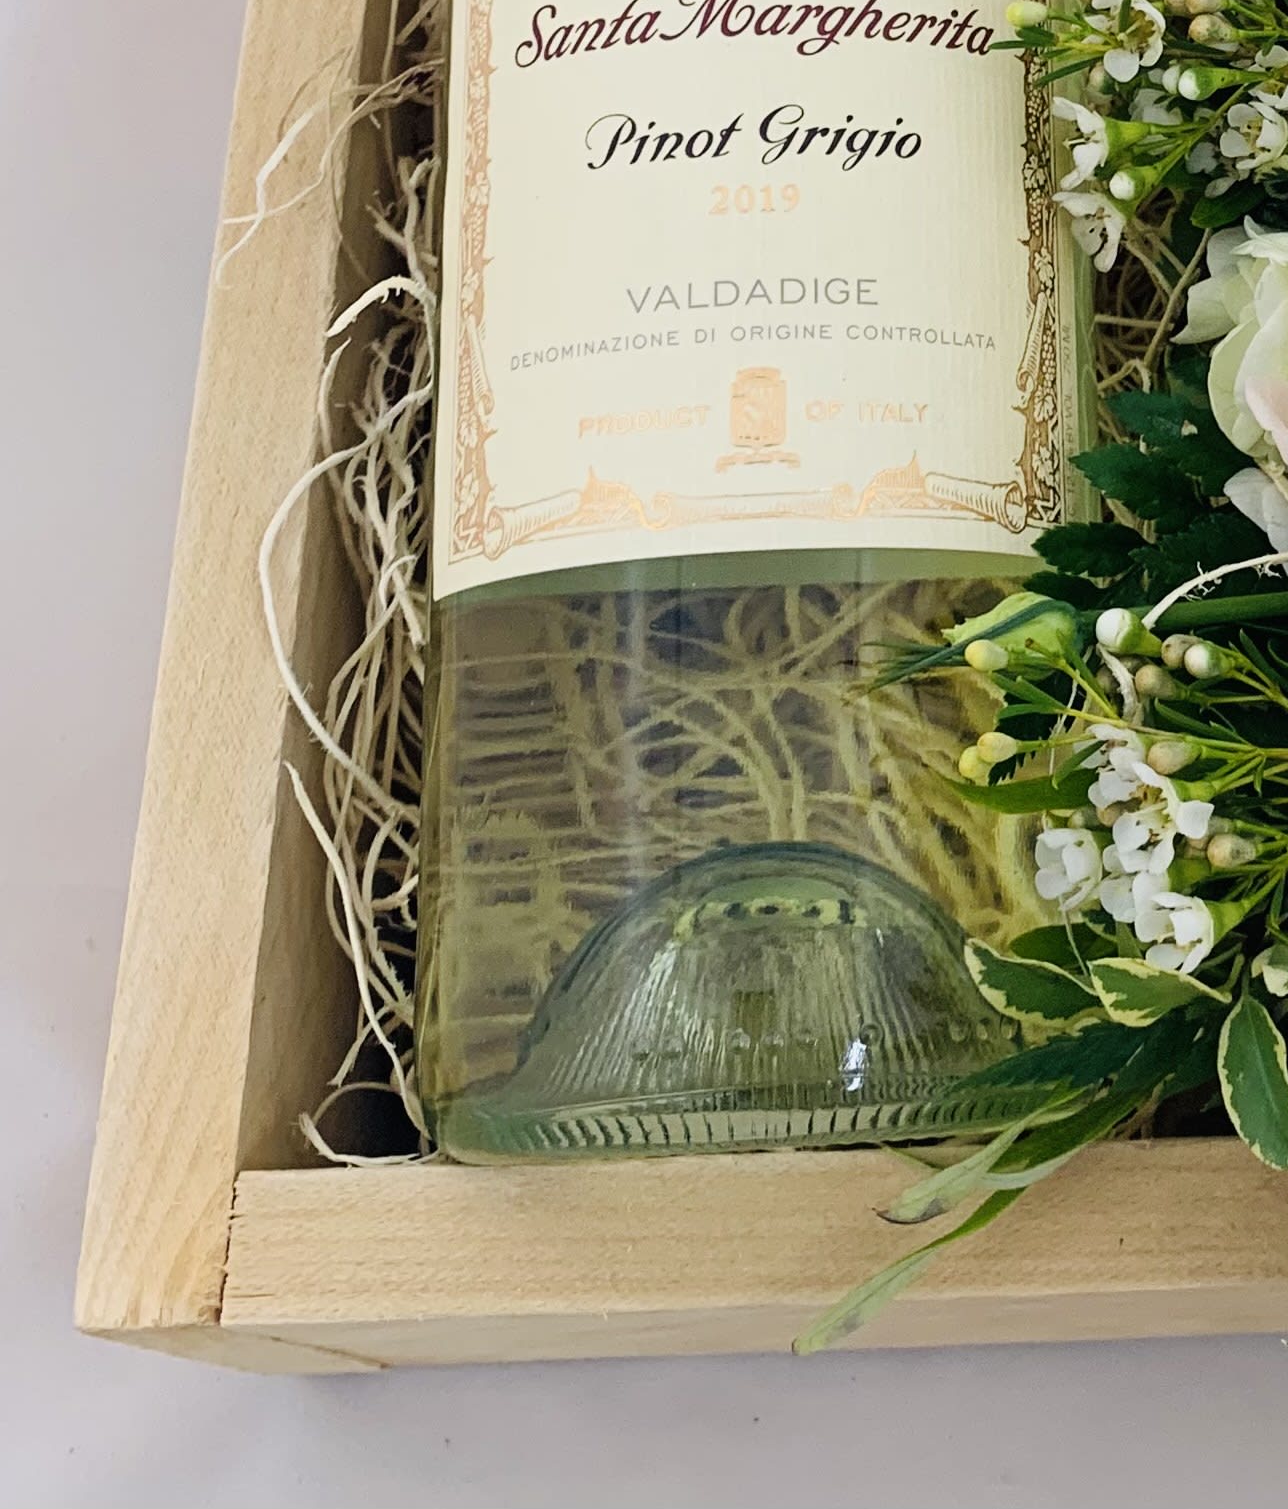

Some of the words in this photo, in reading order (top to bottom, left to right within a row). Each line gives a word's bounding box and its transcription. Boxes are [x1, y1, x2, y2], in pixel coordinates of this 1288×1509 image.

[586, 112, 744, 171] Pinot
[758, 103, 923, 172] Grigio
[708, 182, 802, 216] 2019
[625, 276, 881, 315] VALDADIGE
[509, 328, 681, 372] DENOMINAZIONE
[693, 328, 717, 345] DI
[730, 322, 834, 343] ORIGINE
[845, 323, 998, 352] CONTROLLATA
[577, 403, 711, 440] PRODUCT
[804, 400, 845, 422] OF
[857, 400, 930, 426] ITALY
